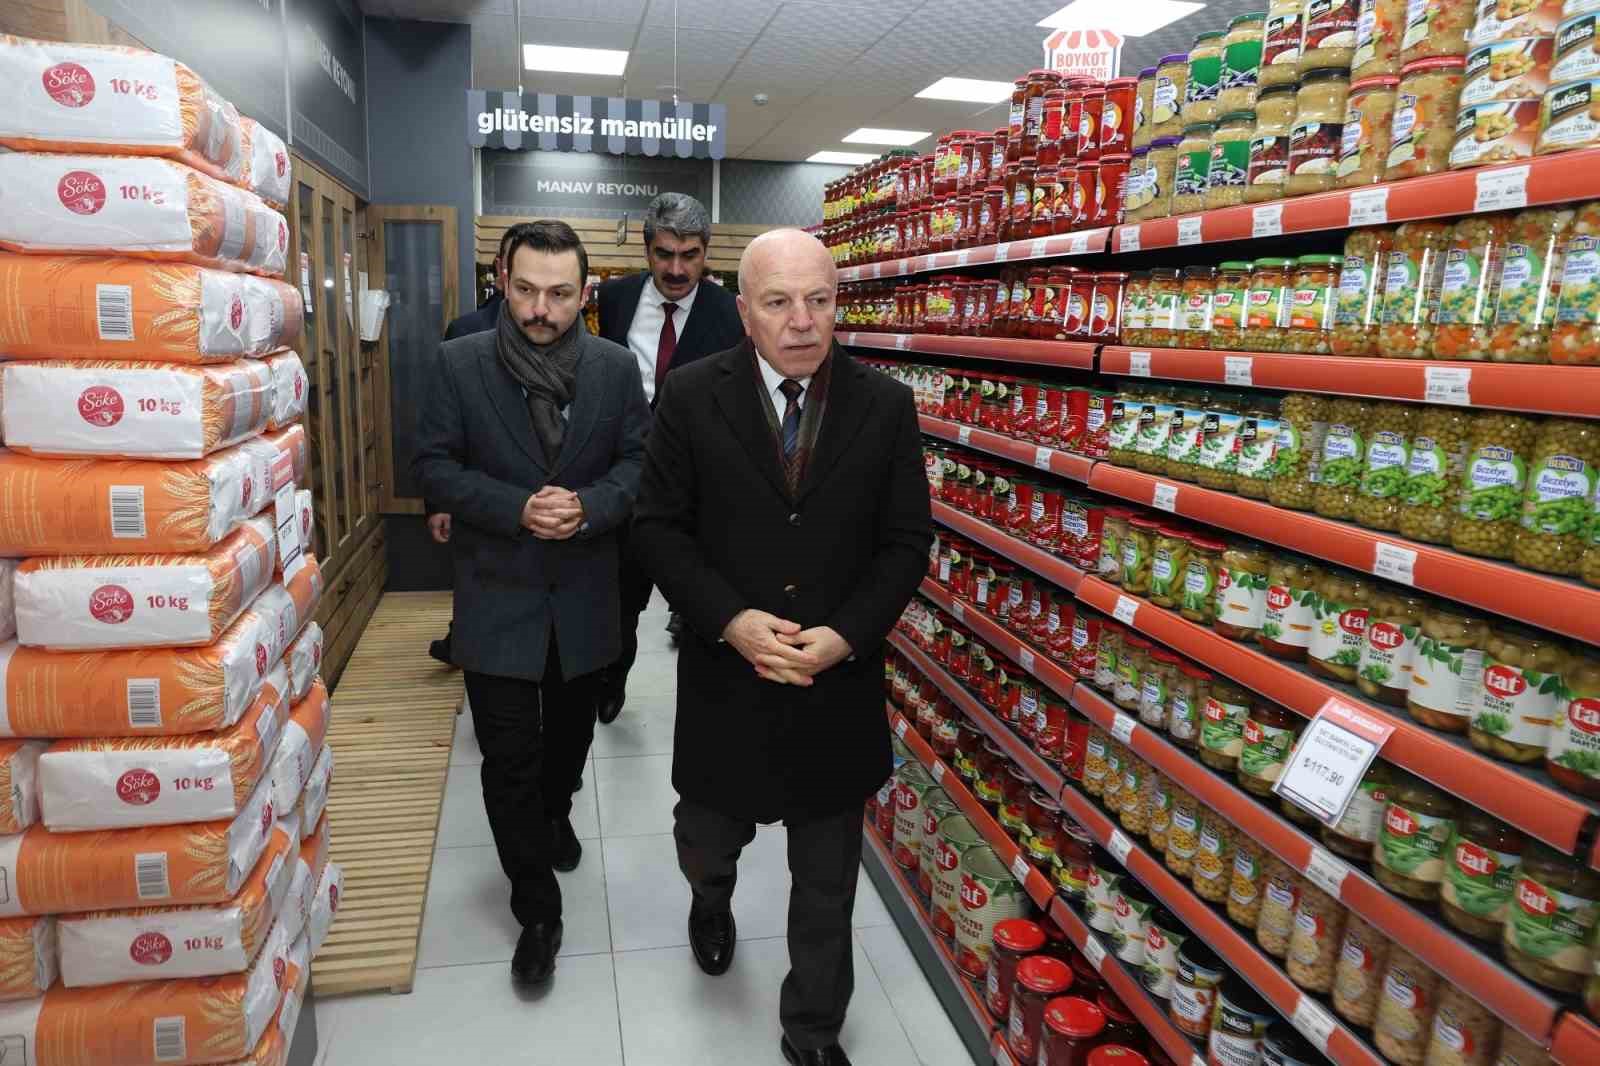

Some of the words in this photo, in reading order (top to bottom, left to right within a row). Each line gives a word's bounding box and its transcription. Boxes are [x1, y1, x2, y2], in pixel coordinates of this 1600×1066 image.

[1056, 51, 1110, 67] BOYKOT
[48, 67, 88, 88] Söke
[110, 78, 130, 94] 10
[133, 79, 158, 101] kg
[477, 108, 594, 135] glütensiz
[600, 117, 718, 142] mamüller
[63, 176, 100, 198] Söke
[119, 186, 138, 199] 10
[142, 186, 165, 204] kg
[536, 180, 593, 194] MANAV
[596, 182, 659, 197] REYONU
[81, 390, 118, 410] Söke
[137, 398, 156, 412] 10
[159, 397, 182, 416] kg
[95, 590, 128, 610] Söke
[147, 596, 166, 609] 10
[168, 595, 189, 611] kg
[1343, 612, 1366, 629] ta
[1370, 625, 1399, 646] tat
[1487, 669, 1521, 693] tat
[1573, 703, 1600, 727] ta
[120, 773, 153, 792] Söke
[173, 778, 191, 791] 10
[194, 775, 215, 792] kg
[895, 790, 913, 808] at
[1387, 811, 1411, 834] tat
[936, 850, 953, 869] at
[1457, 847, 1490, 875] tat
[960, 884, 983, 905] at
[1520, 883, 1551, 914] tat
[135, 936, 167, 954] Söke
[183, 939, 201, 951] 10
[204, 936, 224, 951] kg
